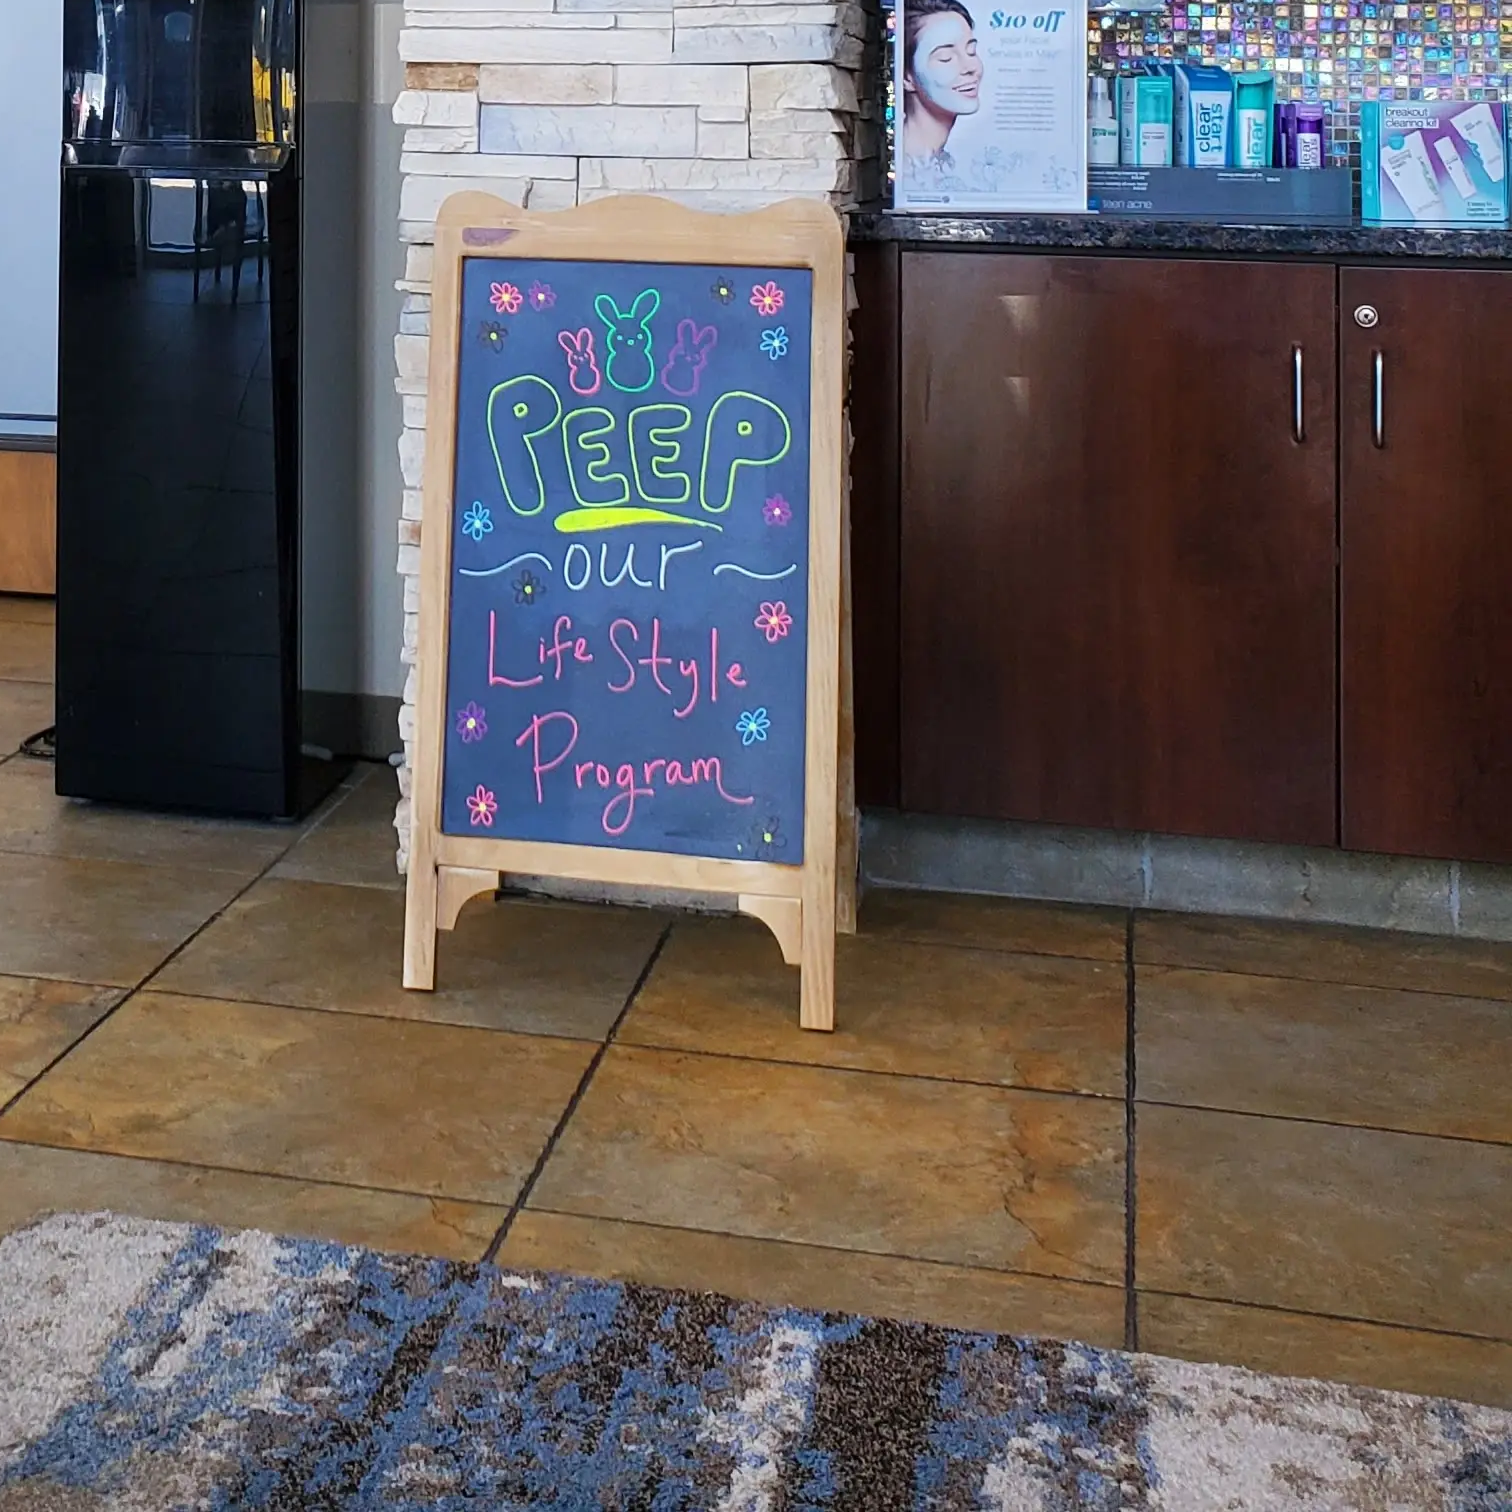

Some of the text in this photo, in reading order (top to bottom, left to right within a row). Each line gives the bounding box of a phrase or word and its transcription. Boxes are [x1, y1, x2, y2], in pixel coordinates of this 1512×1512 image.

[989, 9, 1065, 32] $10 off
[1196, 103, 1210, 153] clear
[1211, 103, 1223, 152] start
[1426, 119, 1437, 127] kit
[1103, 199, 1152, 208] teen acne
[488, 374, 791, 516] PEEP
[563, 541, 702, 590] our
[488, 610, 746, 718] Life Style
[516, 711, 755, 836] Program
